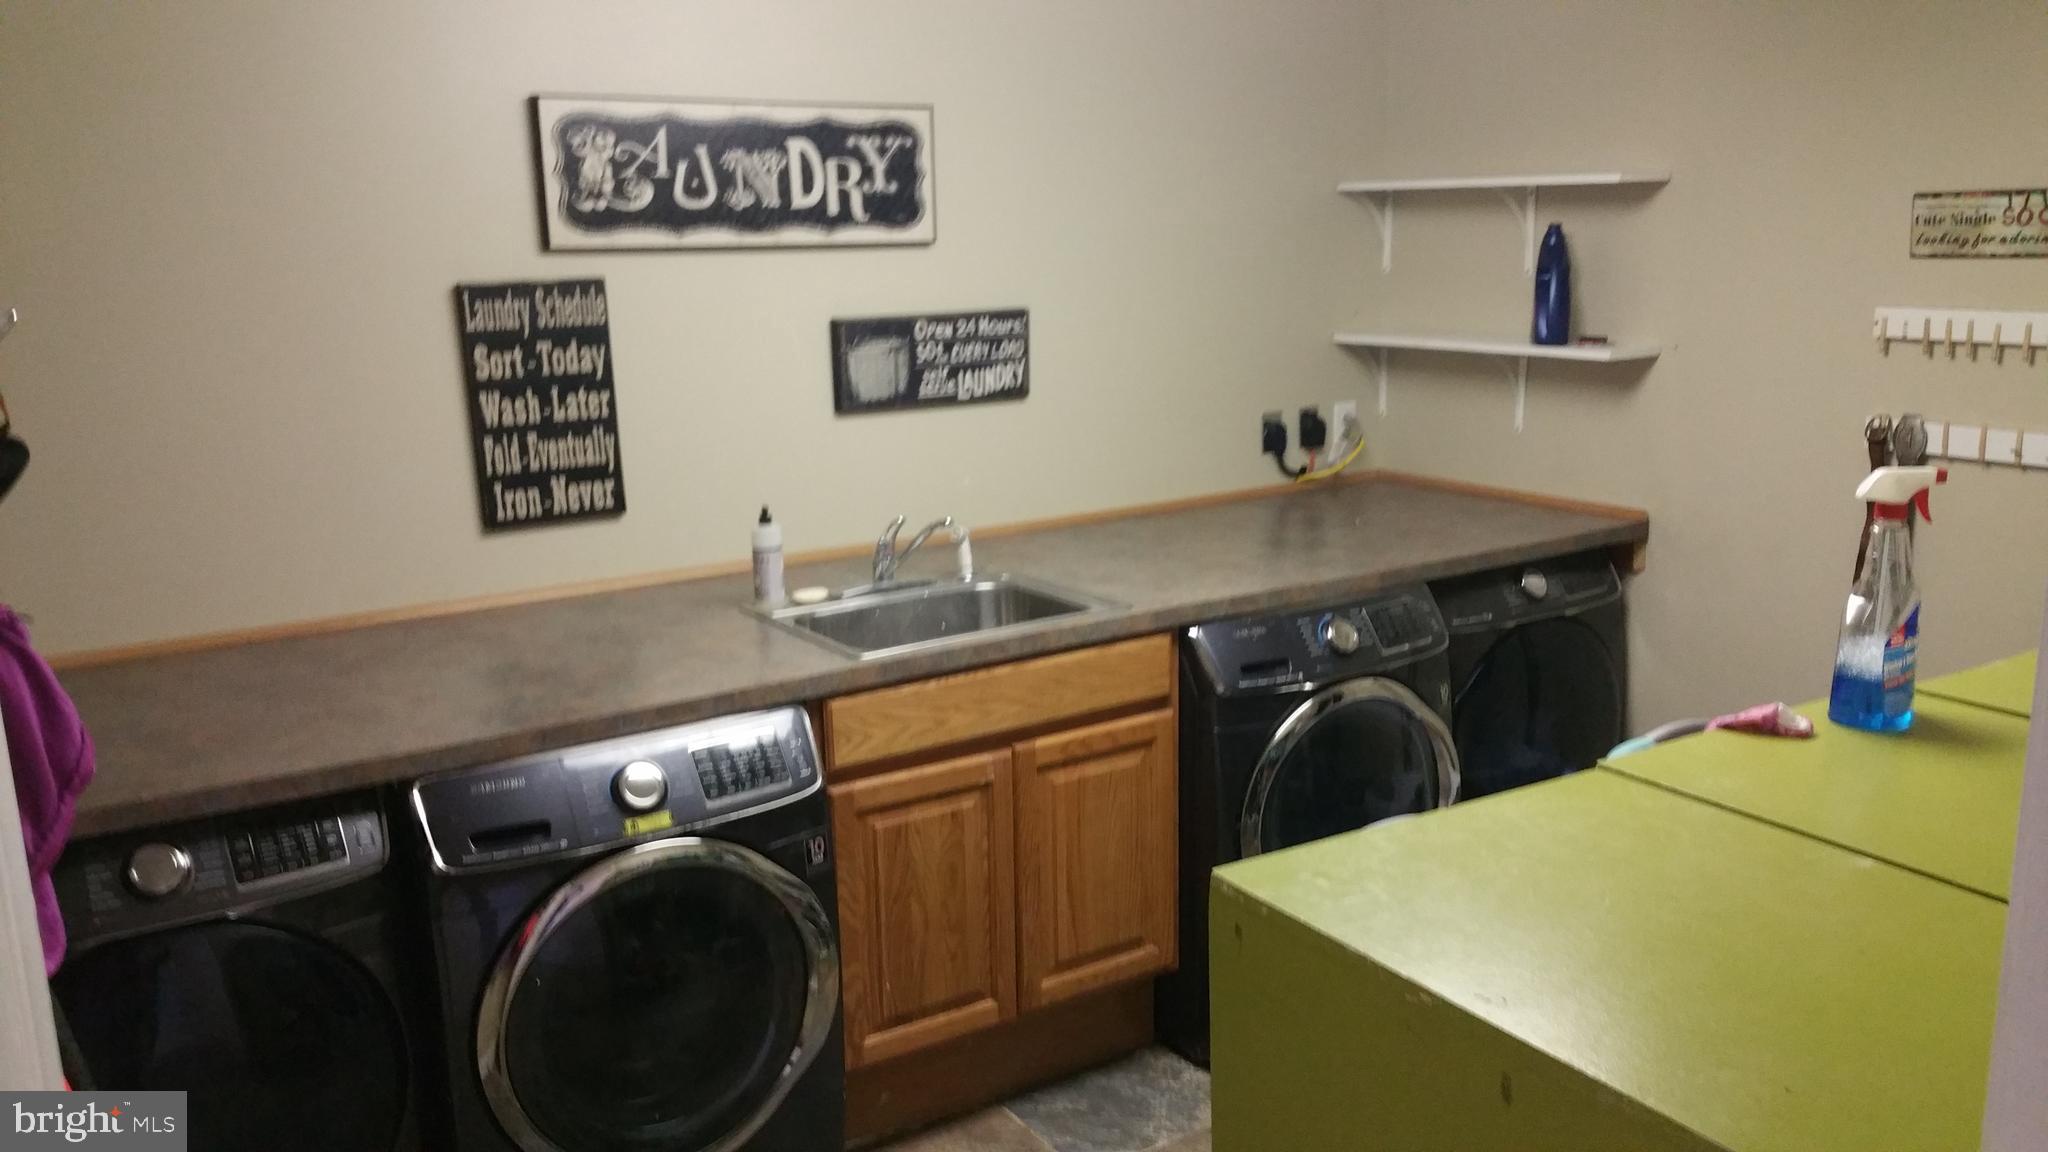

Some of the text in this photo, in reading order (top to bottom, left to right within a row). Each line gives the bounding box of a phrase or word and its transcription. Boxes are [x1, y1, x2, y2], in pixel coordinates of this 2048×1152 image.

[567, 124, 913, 223] LAUNDRY
[1915, 232, 1970, 249] looking
[1971, 232, 1996, 249] for
[463, 284, 606, 340] Laundry Schedule
[956, 317, 977, 338] 24
[957, 357, 1026, 400] LAUNDRY
